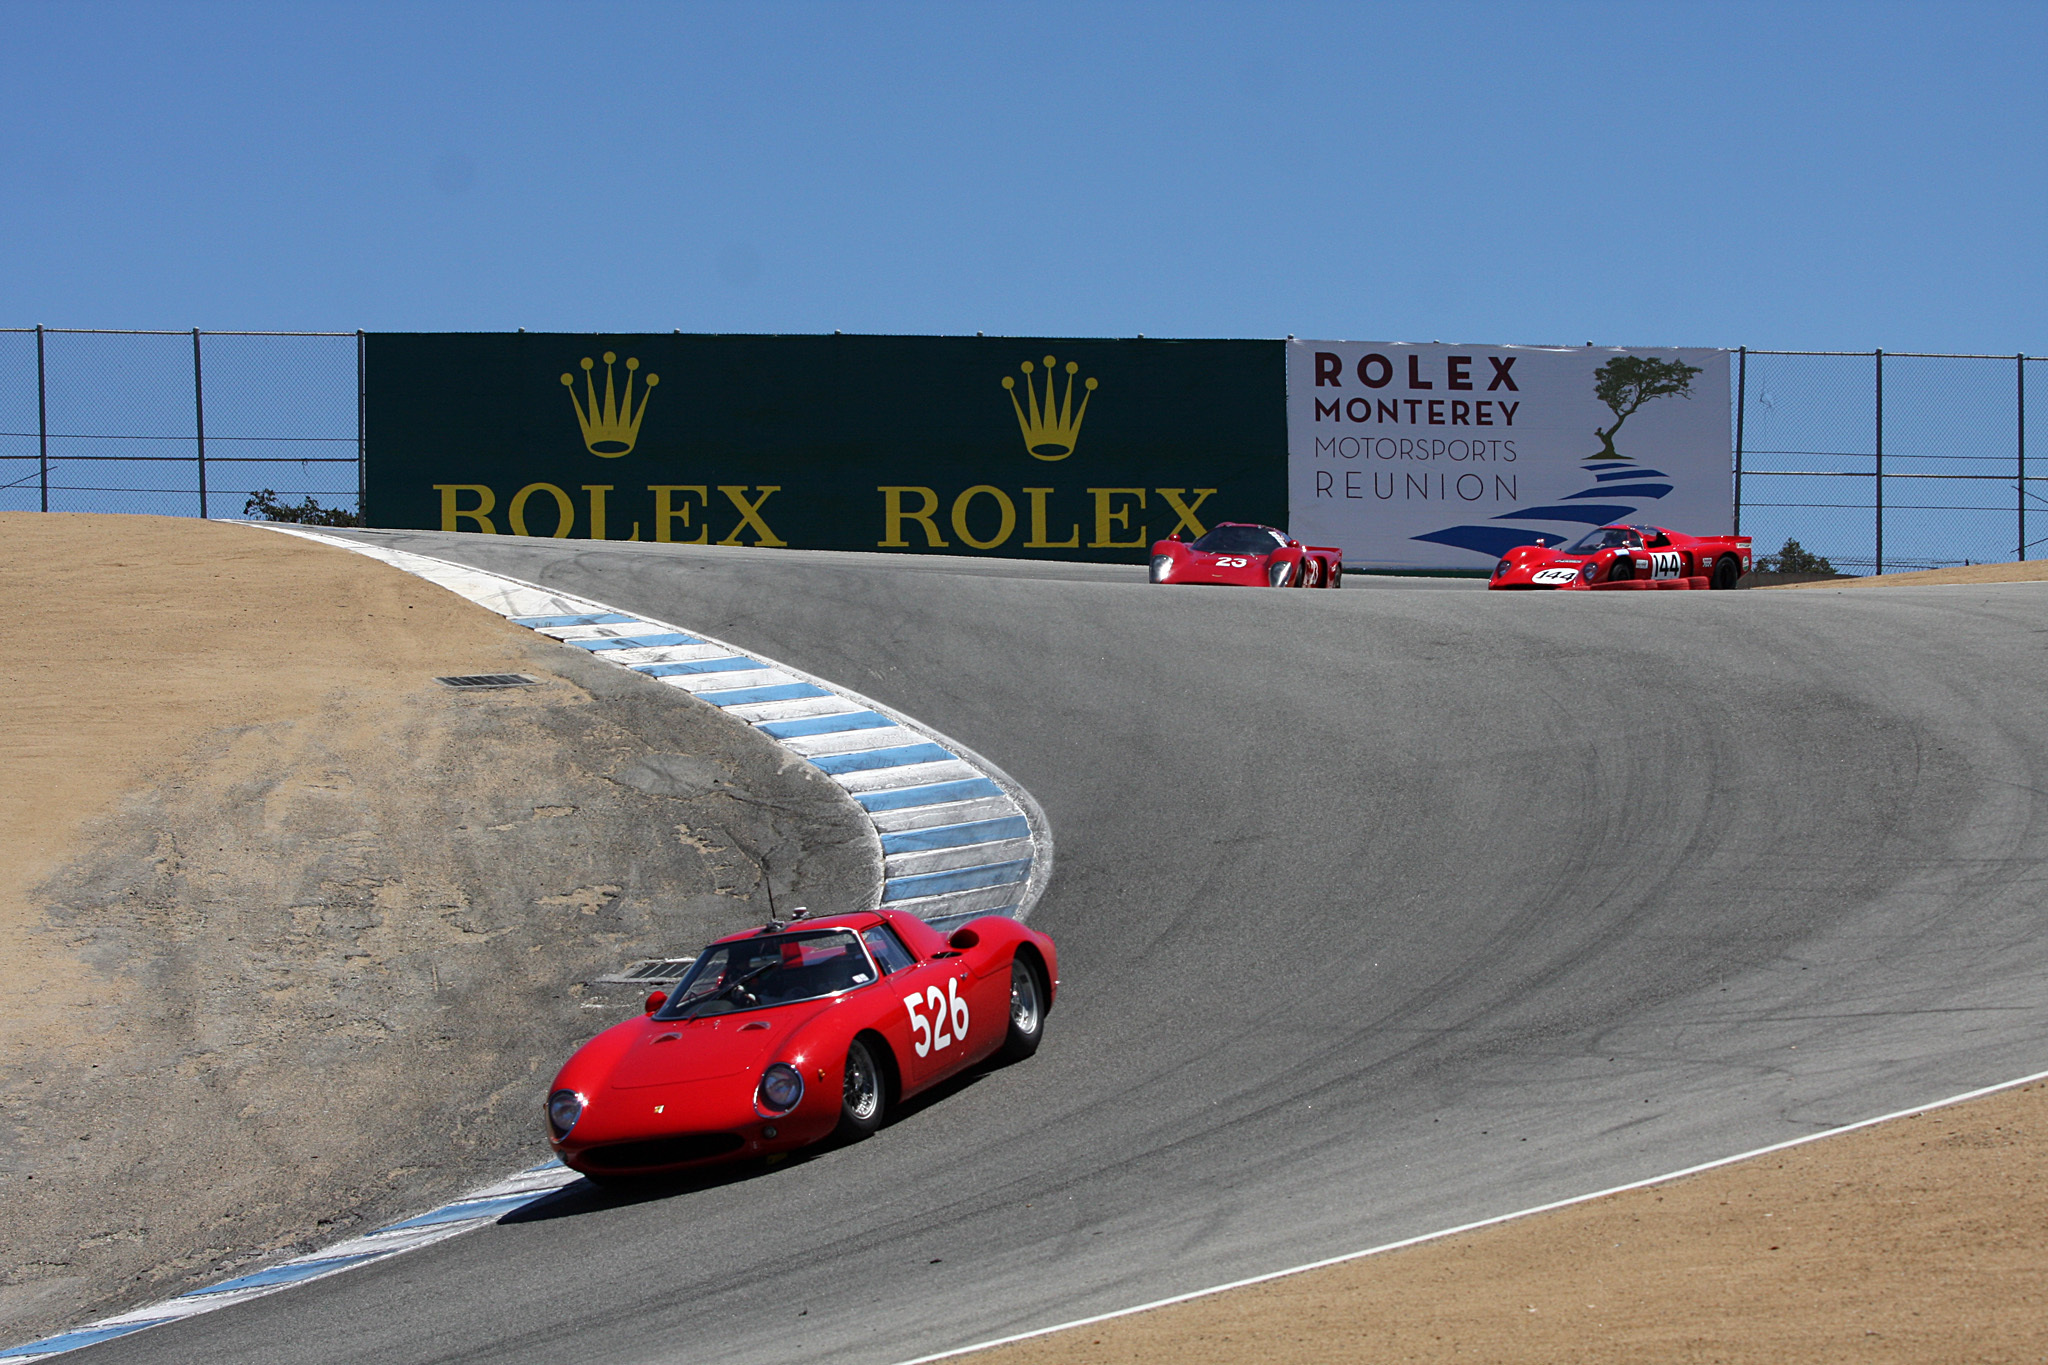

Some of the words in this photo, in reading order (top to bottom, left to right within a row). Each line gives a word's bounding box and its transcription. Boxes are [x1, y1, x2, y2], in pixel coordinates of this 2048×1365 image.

[1315, 352, 1519, 392] ROLEX
[1315, 397, 1520, 427] MONTEREY
[1315, 436, 1518, 462] MOTORSPORTS
[1316, 471, 1518, 501] REUNION
[433, 482, 788, 547] ROLEX
[877, 485, 1217, 549] ROLEX
[1216, 556, 1247, 568] 23
[1538, 570, 1577, 583] 144
[1653, 554, 1680, 578] 144
[903, 977, 970, 1058] 526
